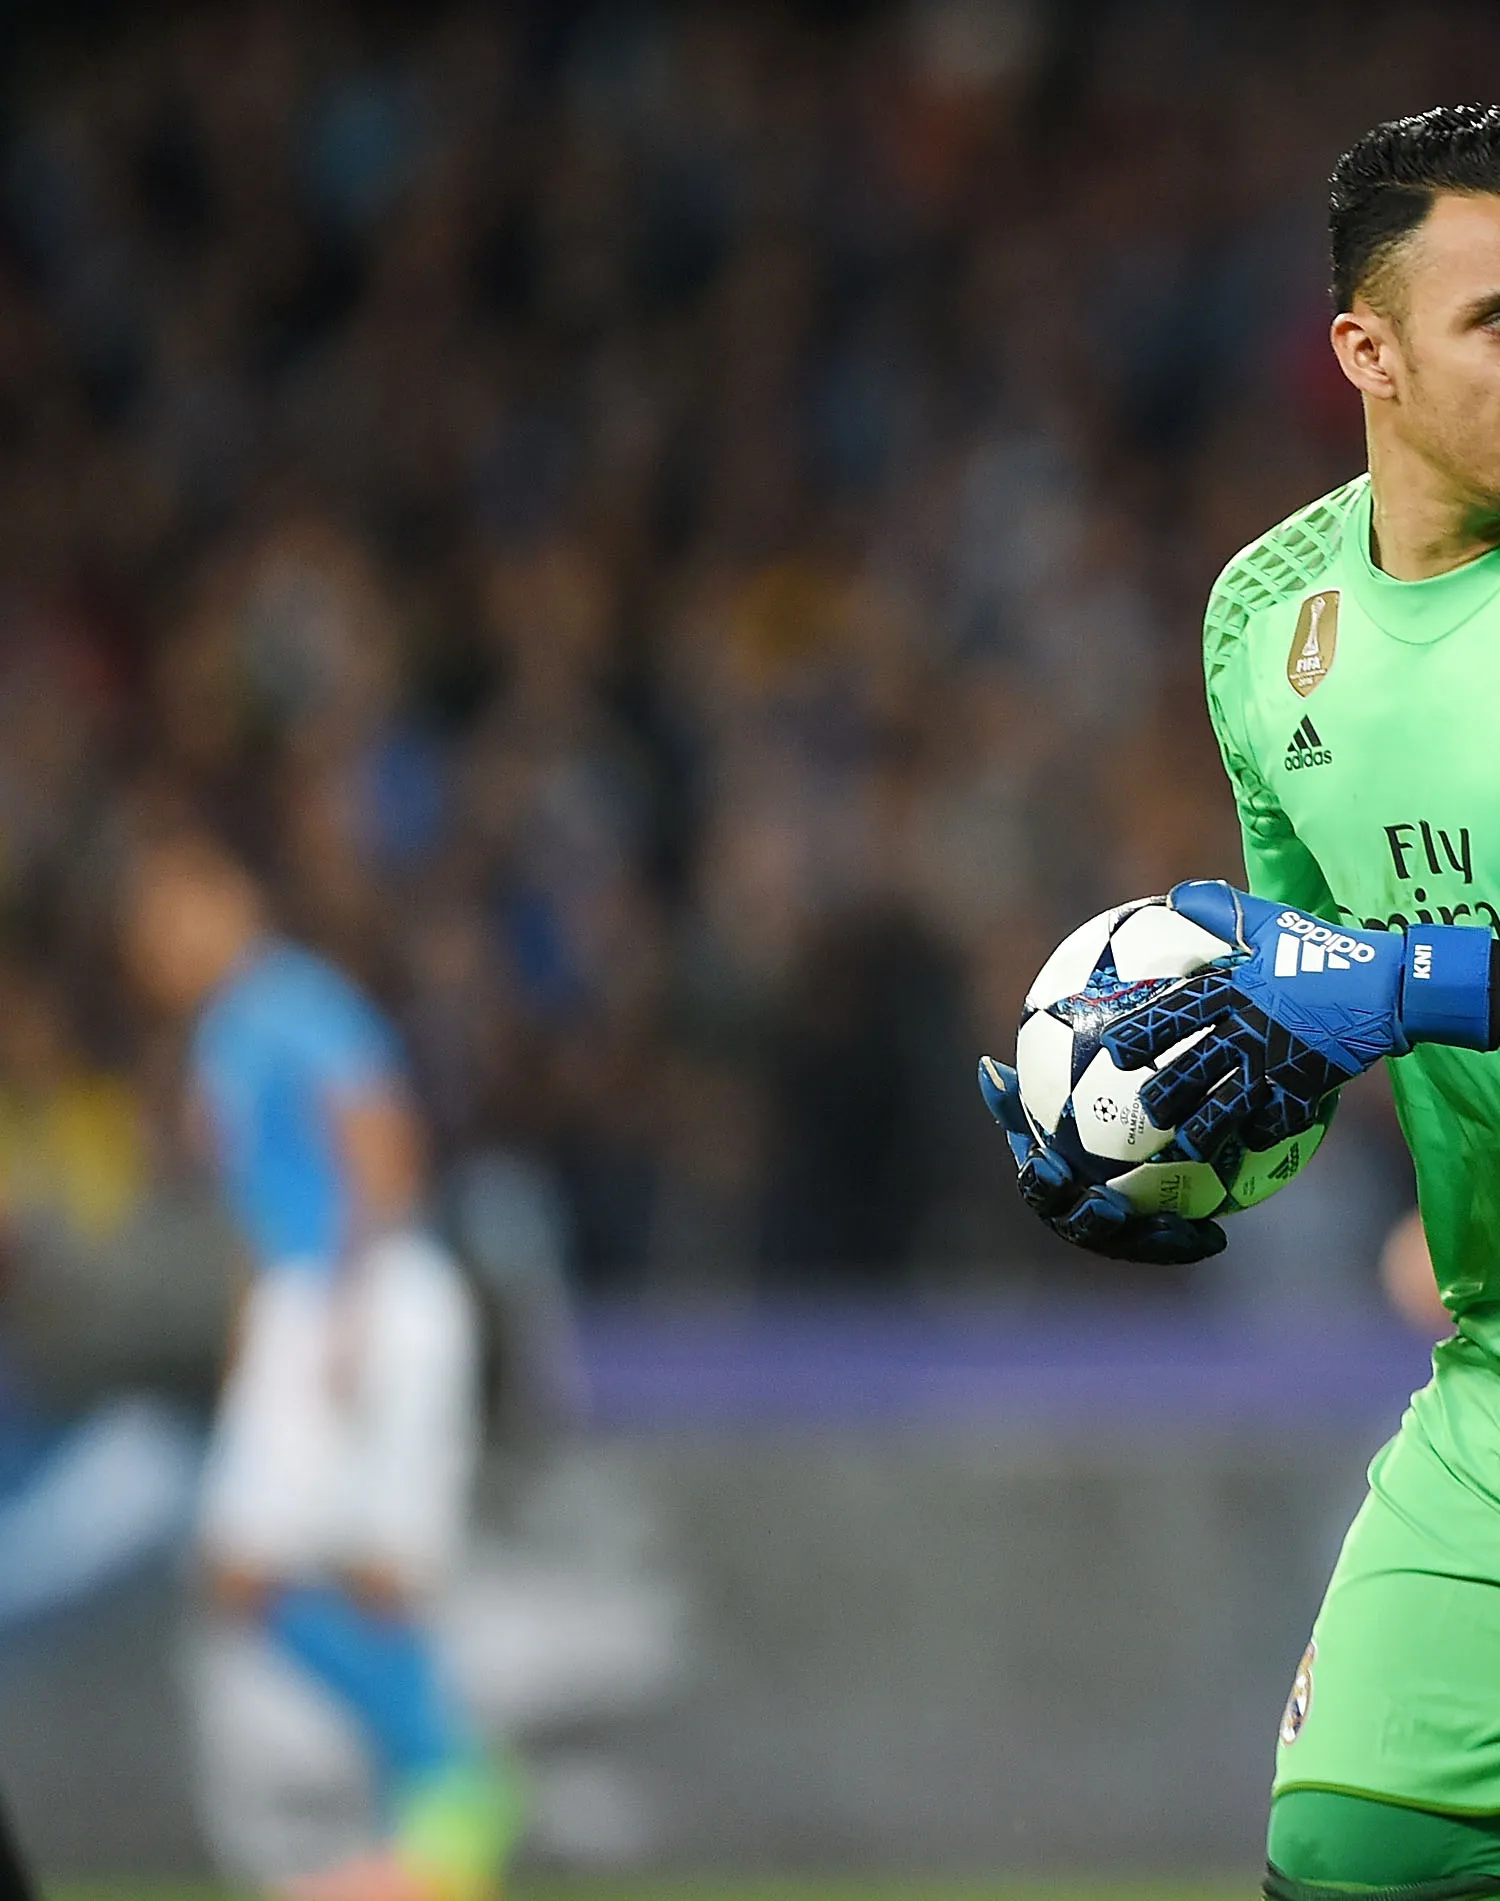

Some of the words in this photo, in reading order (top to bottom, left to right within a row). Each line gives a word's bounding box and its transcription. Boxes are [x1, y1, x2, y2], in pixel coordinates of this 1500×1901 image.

[1284, 748, 1332, 771] adidas
[1383, 820, 1473, 885] Fly
[1276, 911, 1376, 963] adidas
[1413, 944, 1433, 979] KNI
[1127, 1089, 1141, 1145] CHAMPION
